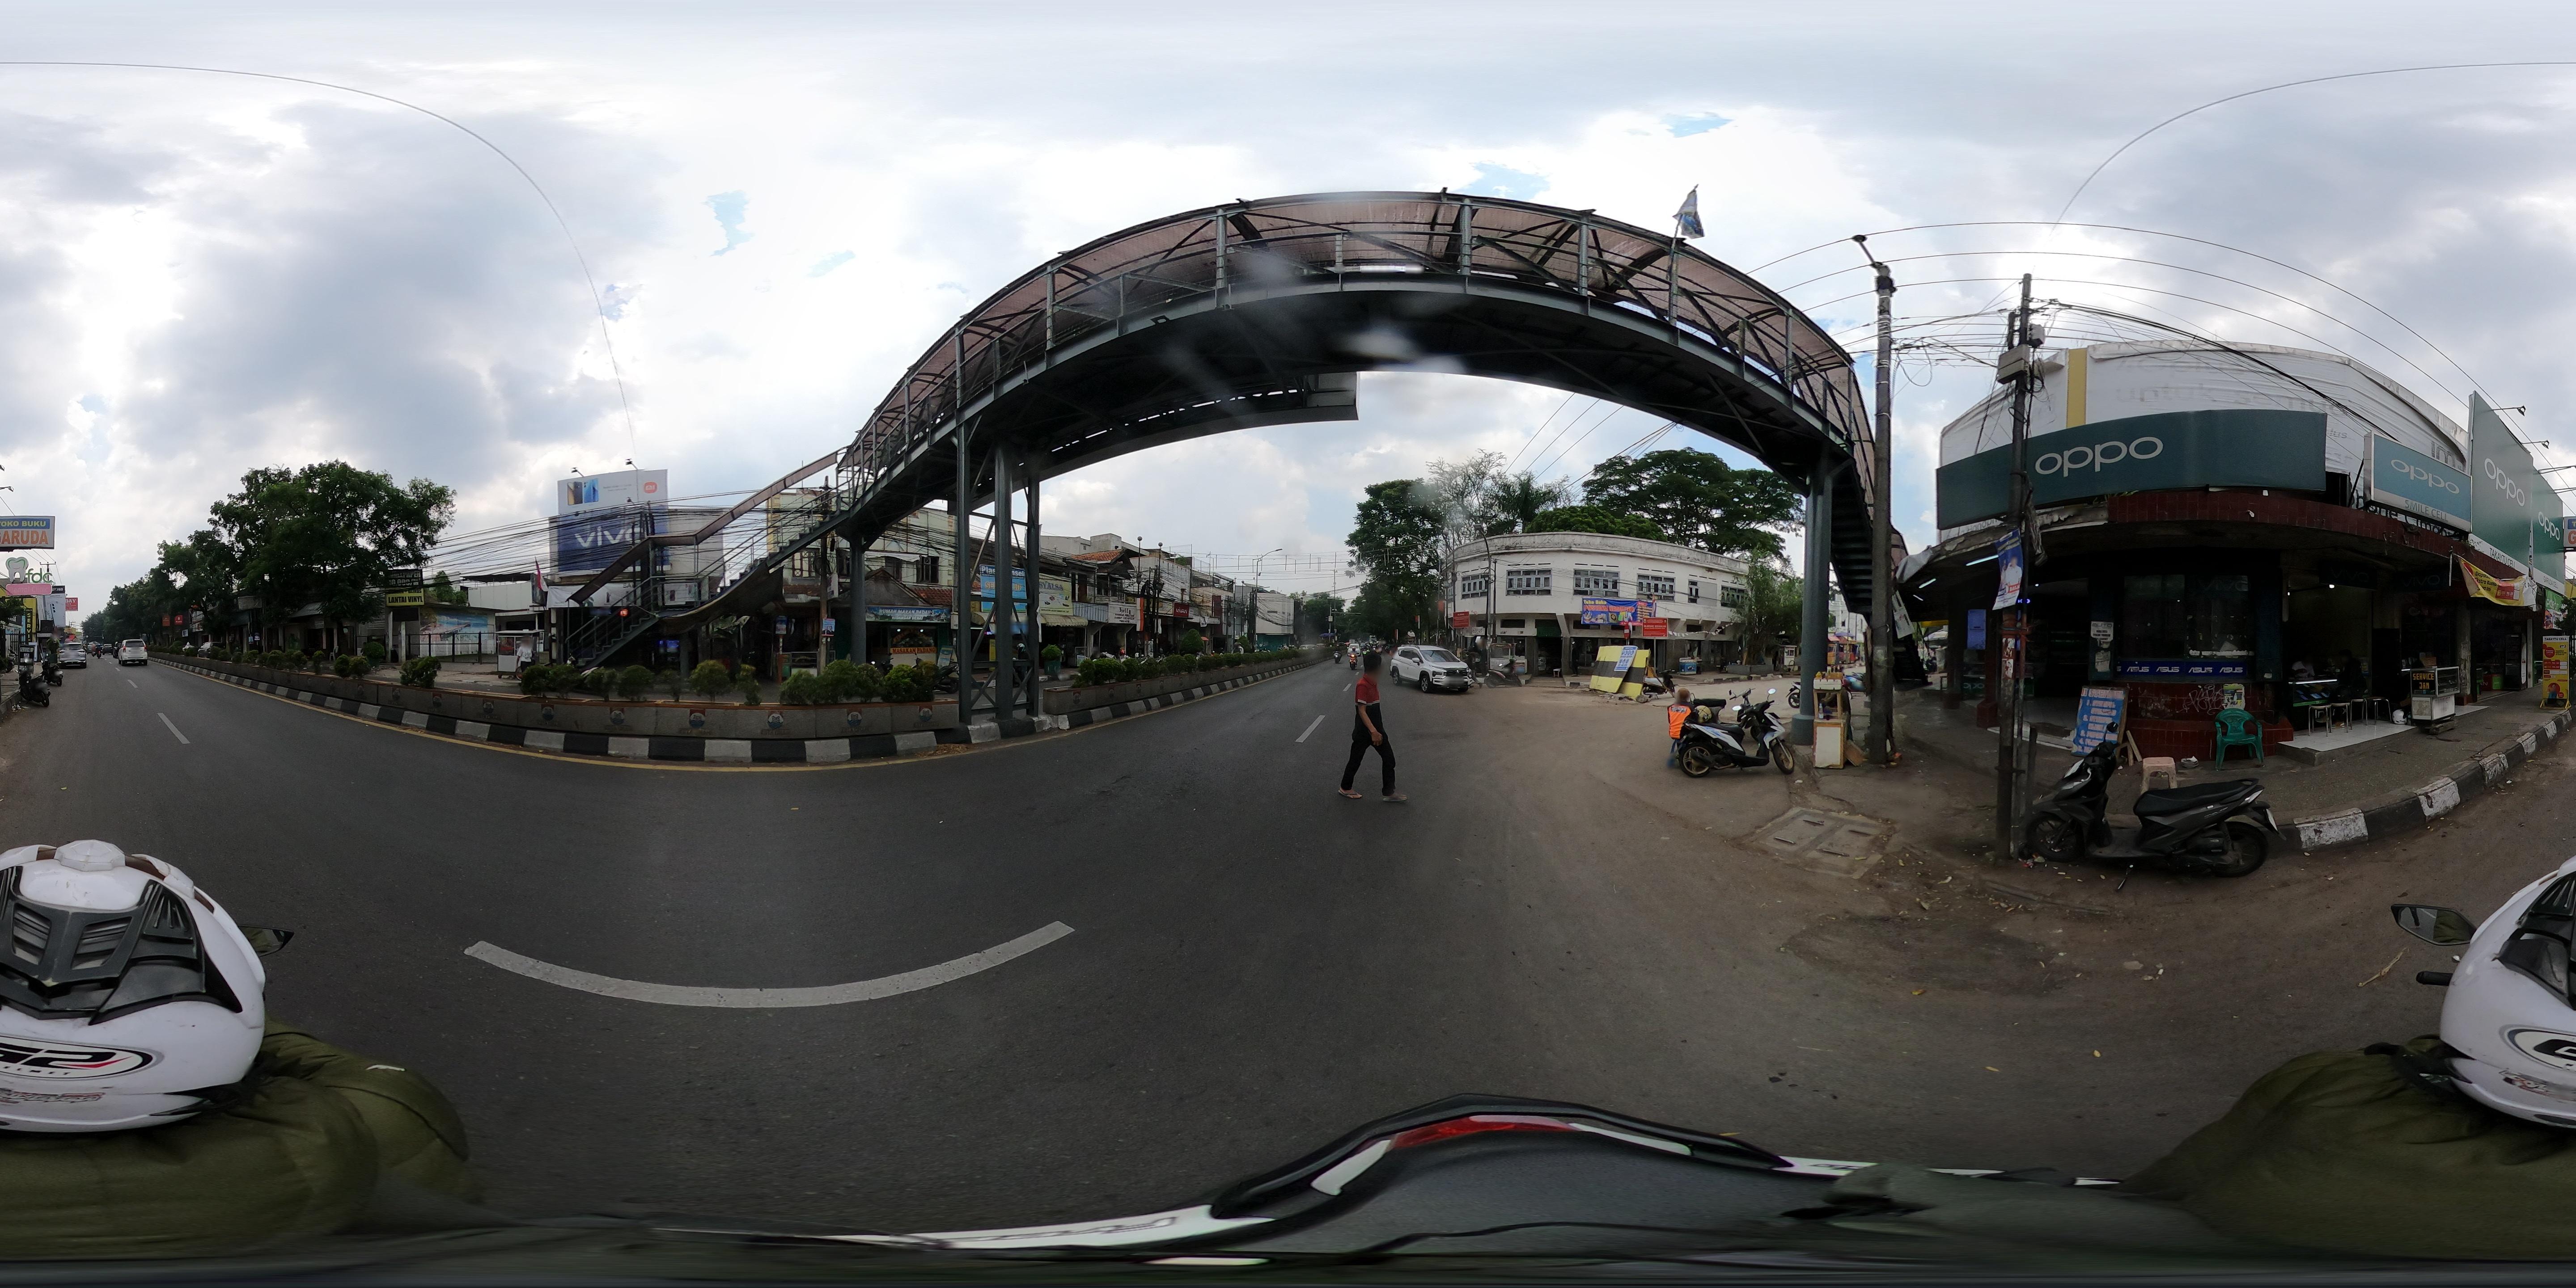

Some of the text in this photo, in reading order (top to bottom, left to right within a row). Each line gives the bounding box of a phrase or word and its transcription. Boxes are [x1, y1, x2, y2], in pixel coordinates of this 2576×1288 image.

[2035, 436, 2164, 477] oppo
[2391, 459, 2460, 494] oppo
[2484, 458, 2525, 506] oppo
[2405, 500, 2429, 515] SMILE
[2431, 508, 2449, 522] CELL
[0, 530, 49, 544] ARUDA
[2538, 512, 2560, 541] oppo
[2489, 547, 2507, 565] TAKAYTU
[25, 568, 53, 583] fdc
